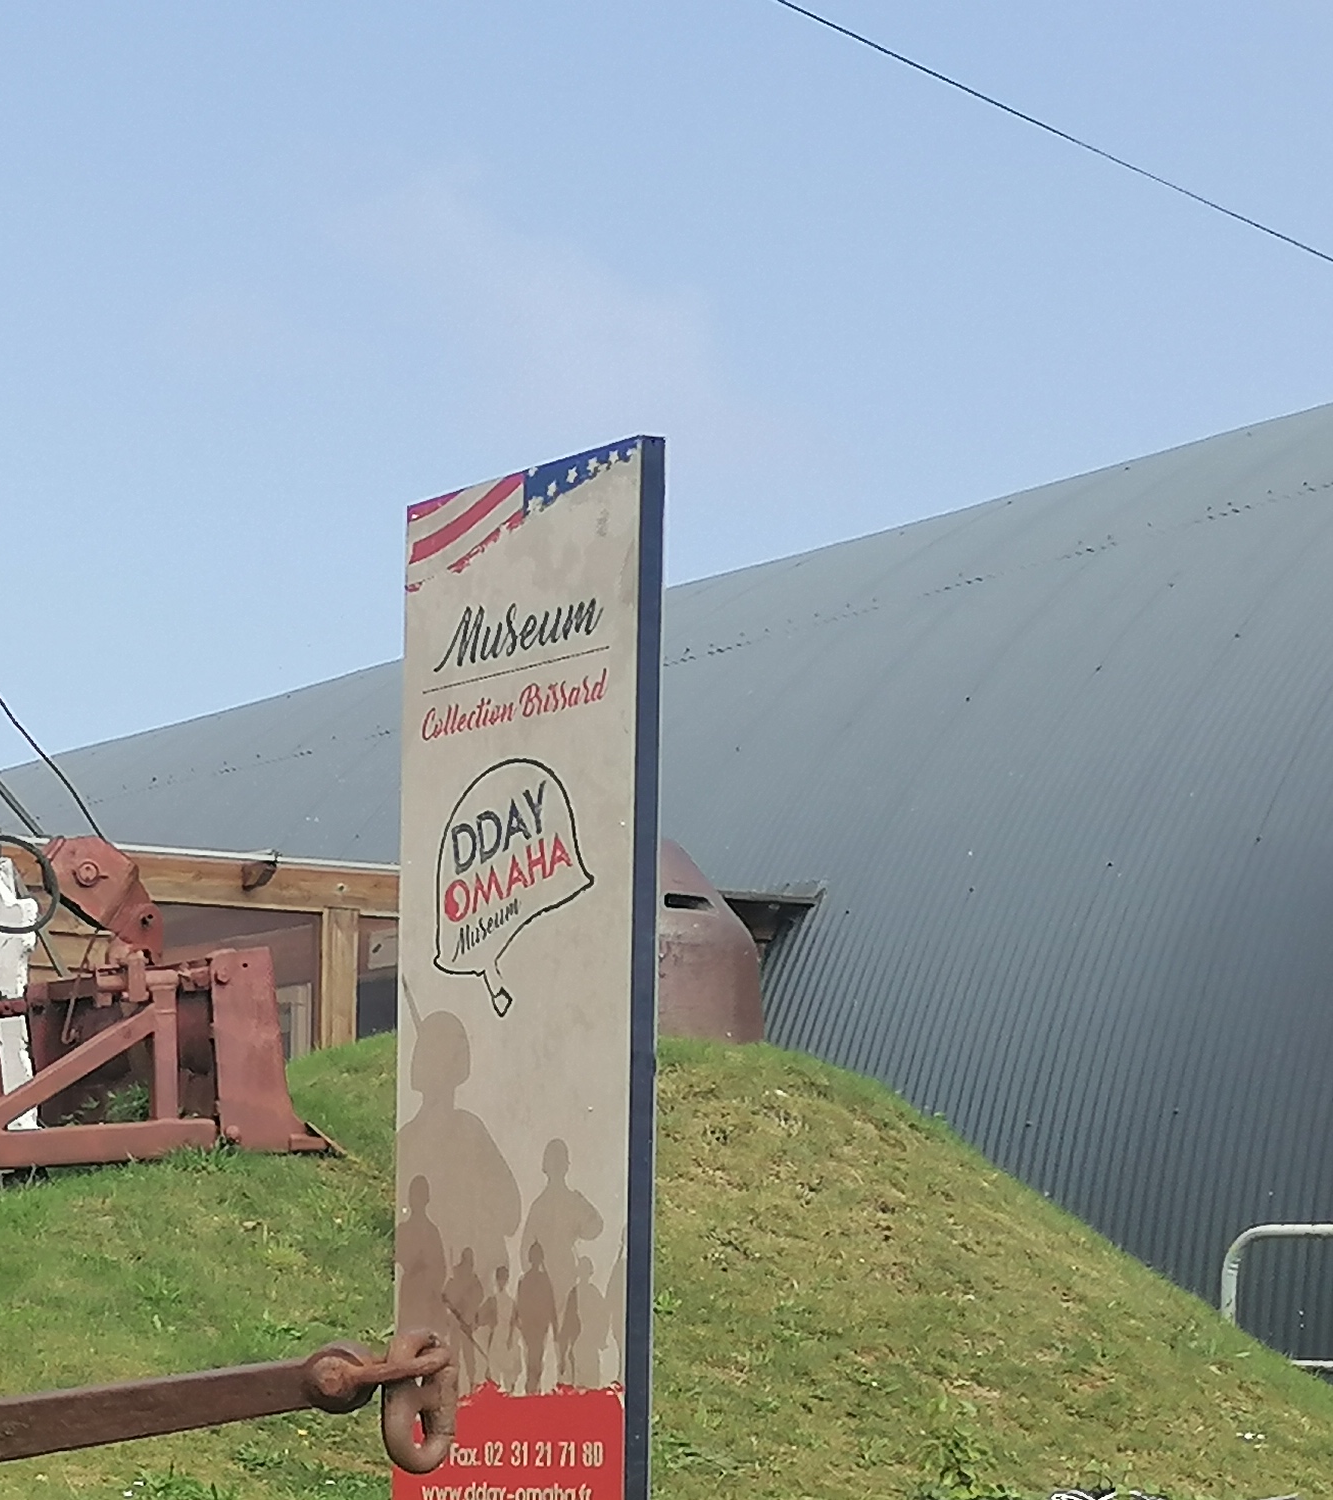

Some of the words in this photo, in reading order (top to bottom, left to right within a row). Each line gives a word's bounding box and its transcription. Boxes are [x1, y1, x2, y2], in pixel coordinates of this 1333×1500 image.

[433, 597, 605, 673] Museum
[421, 697, 515, 742] Collection
[451, 779, 547, 875] DDAY
[444, 832, 574, 923] OMAHA
[451, 897, 522, 963] Museum
[484, 1441, 504, 1467] 02
[510, 1441, 528, 1467] 31
[535, 1441, 552, 1467] 21
[558, 1441, 575, 1467] 71
[582, 1441, 604, 1468] 80
